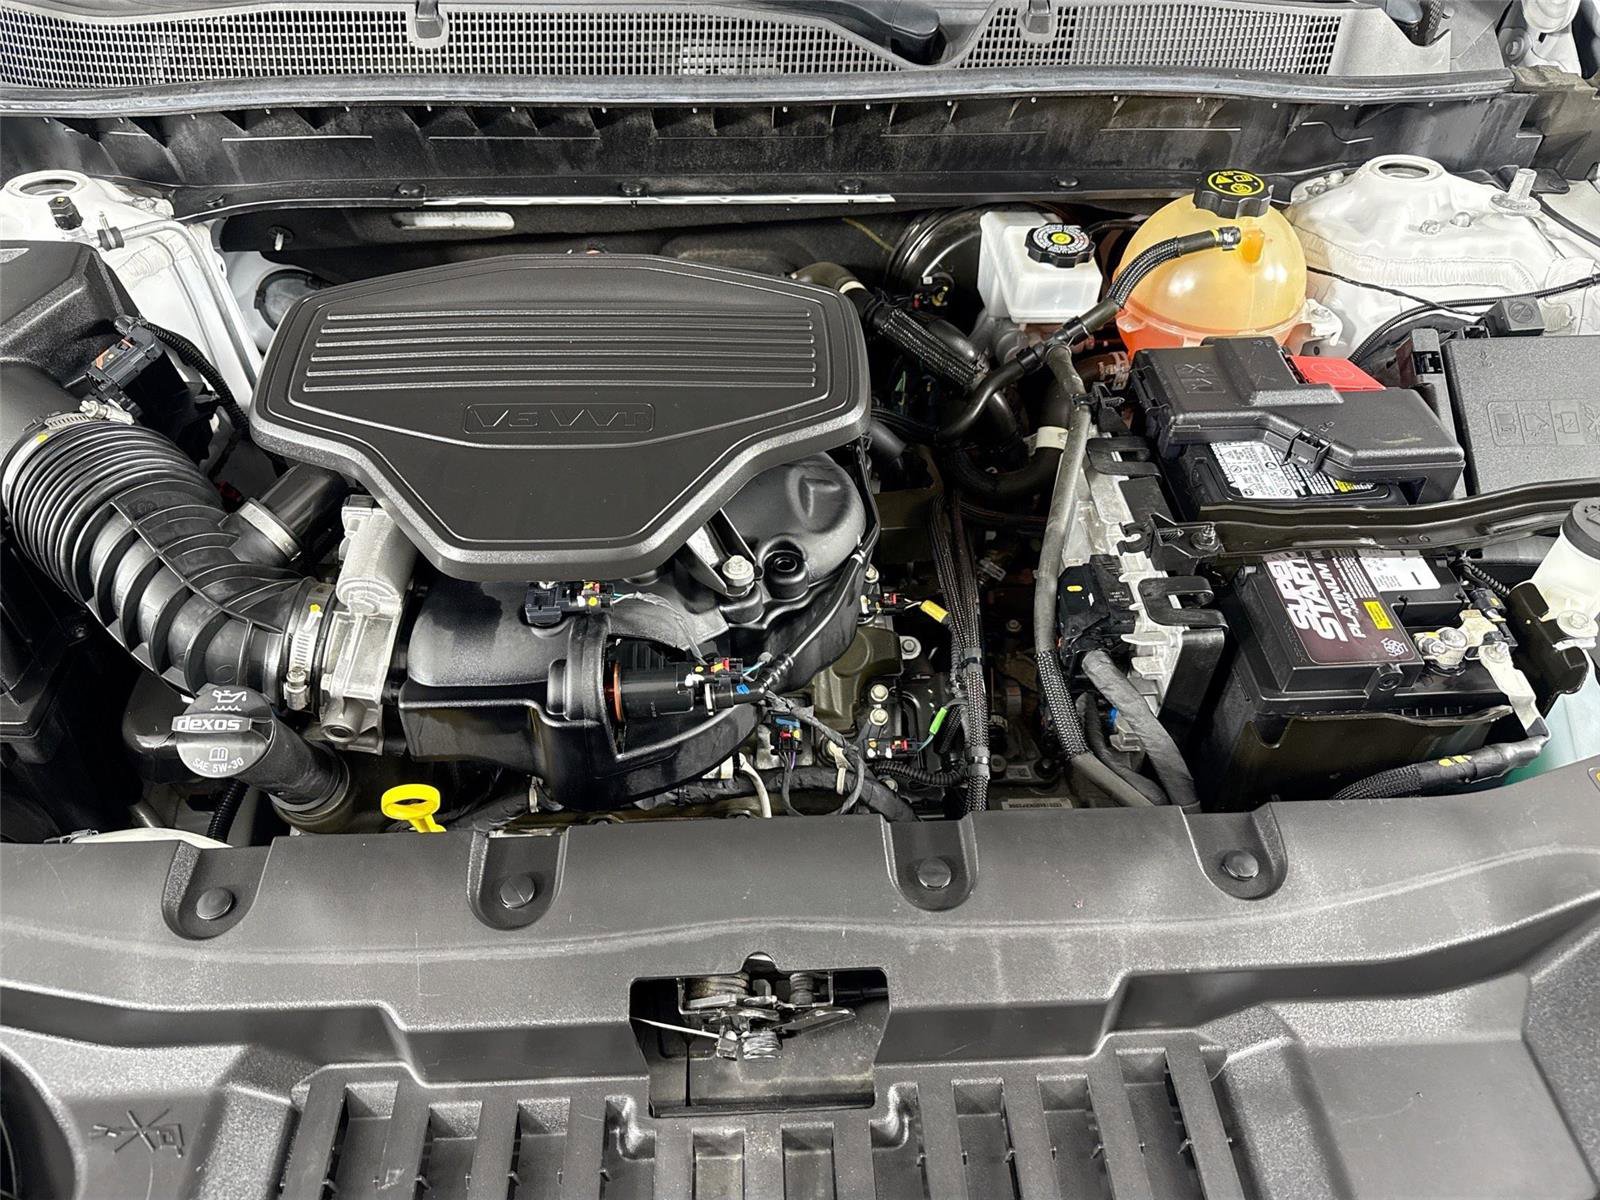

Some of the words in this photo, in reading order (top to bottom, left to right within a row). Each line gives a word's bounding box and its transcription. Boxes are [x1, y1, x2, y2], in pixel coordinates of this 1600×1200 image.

[473, 409, 538, 427] V6
[550, 409, 647, 427] VVT
[1267, 560, 1311, 630] SUPE
[1314, 562, 1367, 638] PLATINUM
[176, 715, 243, 731] dexos
[193, 757, 210, 772] SAE
[212, 756, 245, 773] 5W-30
